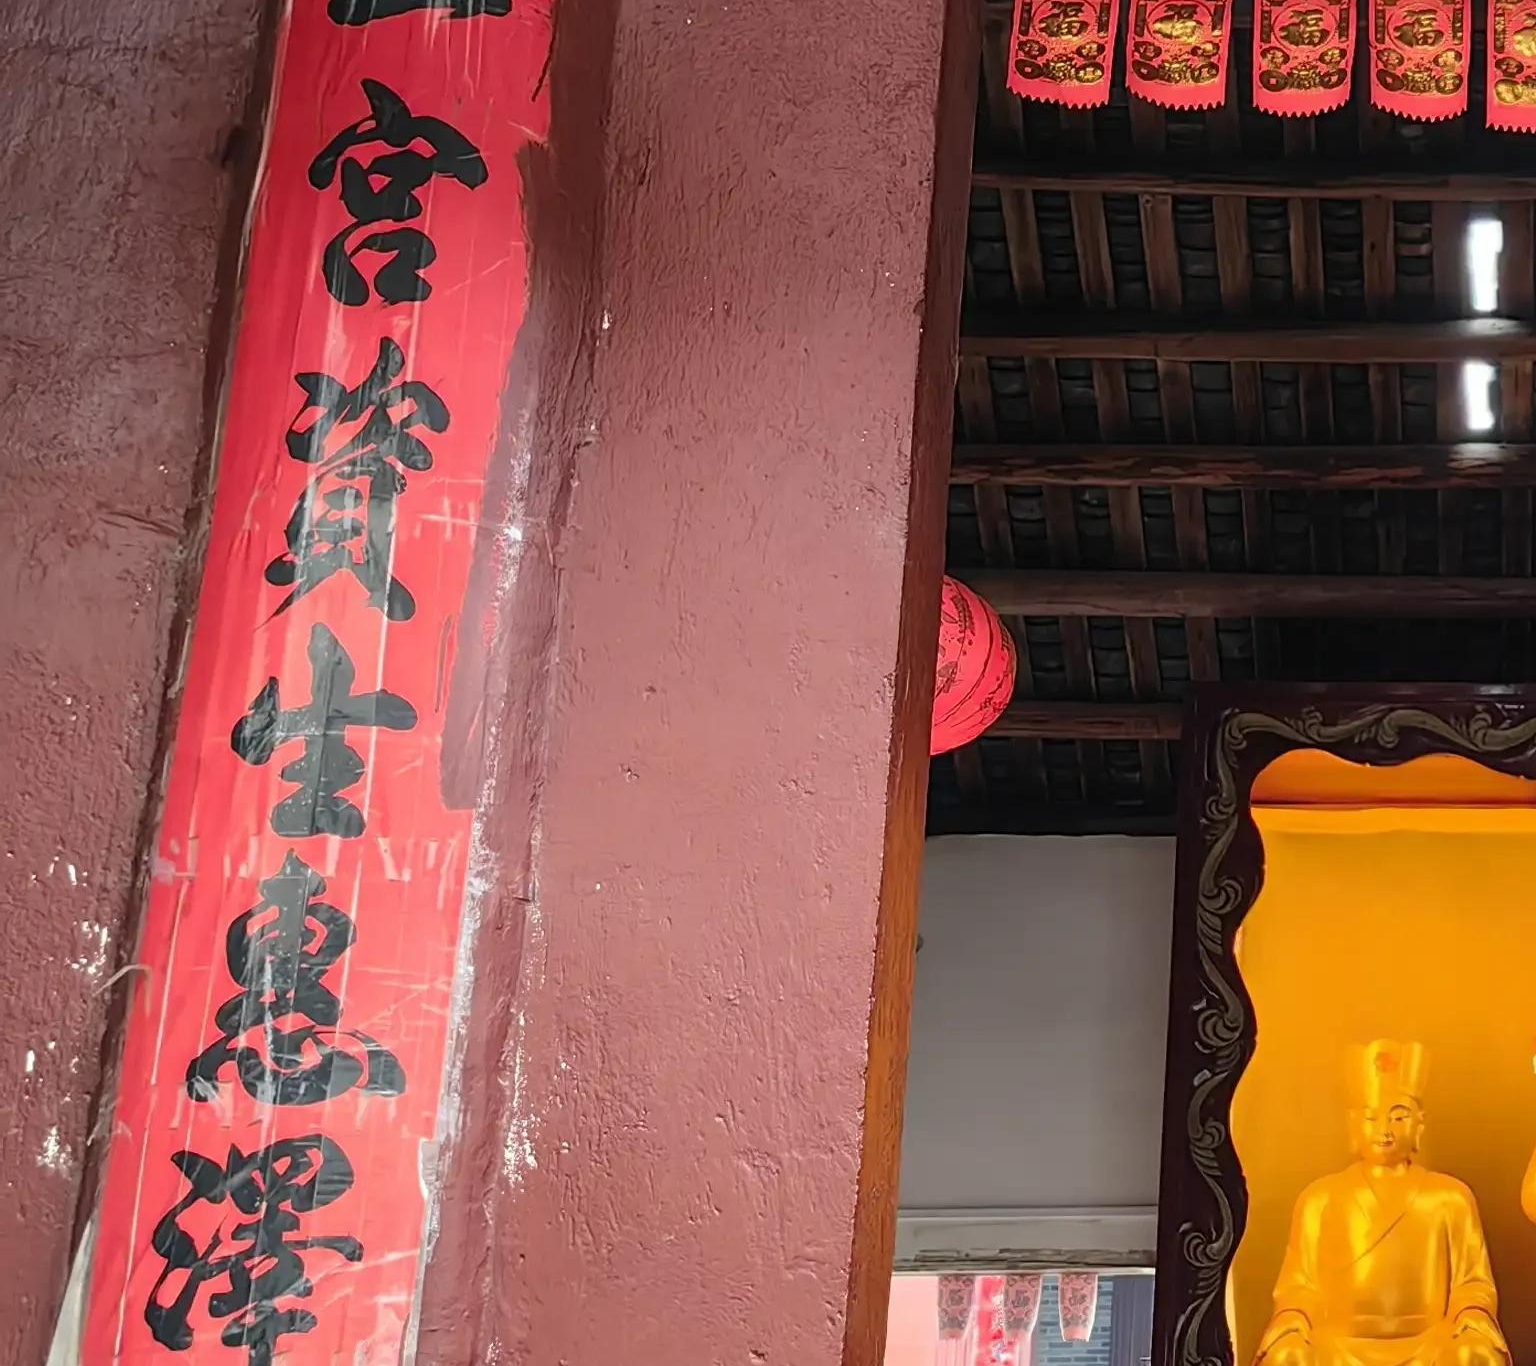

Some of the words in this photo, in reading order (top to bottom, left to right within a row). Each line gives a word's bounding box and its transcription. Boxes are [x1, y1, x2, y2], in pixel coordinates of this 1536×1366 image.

[1038, 1, 1090, 39] 福
[1279, 9, 1330, 48] 福
[1393, 9, 1444, 48] 福
